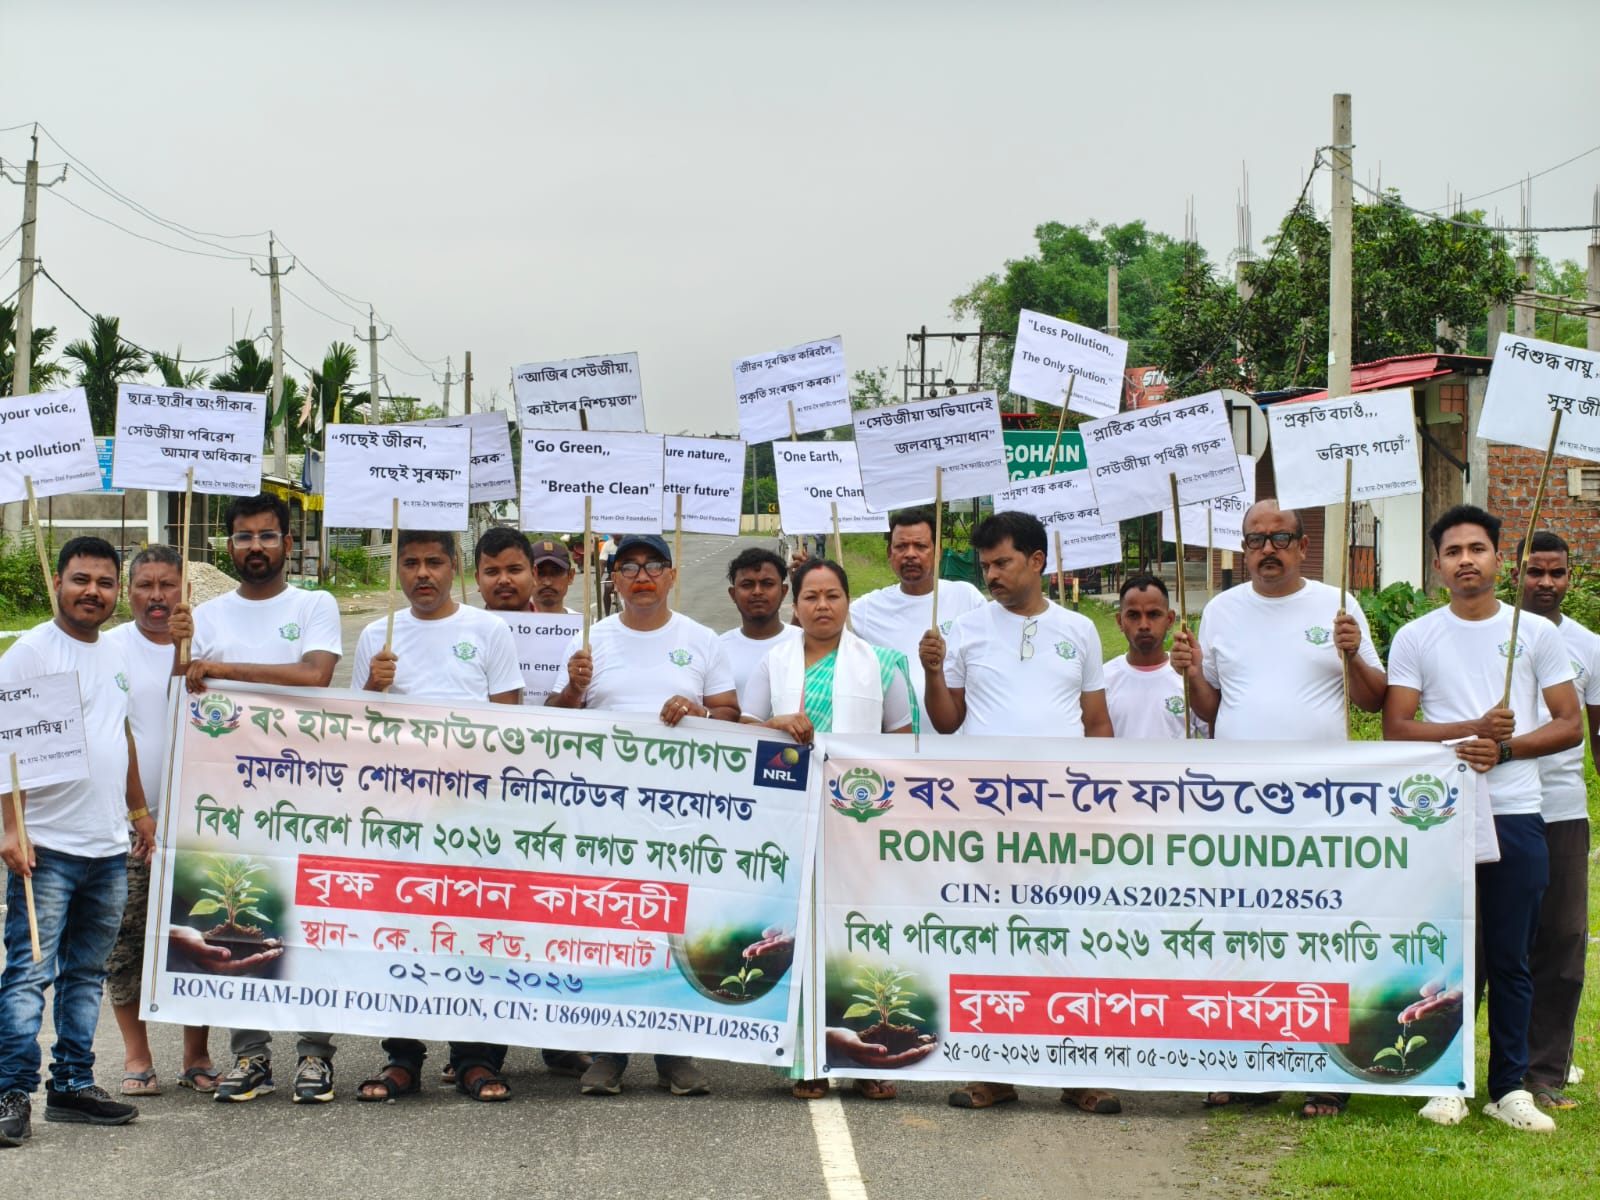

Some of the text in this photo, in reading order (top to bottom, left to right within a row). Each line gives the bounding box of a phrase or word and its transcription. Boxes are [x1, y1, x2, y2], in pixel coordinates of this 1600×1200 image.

[1022, 350, 1040, 364] The
[1043, 357, 1065, 372] Only
[0, 408, 30, 424] your
[160, 447, 200, 459] আমাৰ
[809, 450, 842, 463] Earth,
[370, 464, 408, 481] গছেই
[836, 486, 864, 497] Chan
[518, 624, 531, 634] to
[248, 705, 752, 773] ৰং হাম-দৈ ফাউণ্ডেশ্যনৰ উদ্যোগত
[235, 748, 757, 822] নুমলীগড় শোধনাগাৰ লিমিটেডৰ সহযোগত
[762, 768, 796, 783] NRL
[904, 766, 1383, 817] ৰং হাম-দৈ ফাউণ্ডেশ্যন
[195, 793, 789, 883] বিশ্ব পৰিৱেশ দিৱস ২০২৬ বৰ্ষৰ লগত সংগতি ৰাখি
[879, 829, 1408, 869] RONG HAM-DOI FOUNDATION
[304, 868, 678, 929] বৃক্ষ ৰোপন কাৰ্যসূচী
[940, 883, 1343, 911] CIN: U86909AS2025NPL028563
[545, 936, 655, 969] গোলাঘাট
[844, 910, 1448, 966] বিশ্ব পৰিৱেশ দিৱস ২০২৬ বৰ্ষৰ লগত সংগতি ৰাখি
[389, 961, 583, 994] ০২-০৬-২০২৬
[172, 977, 780, 1044] RONG HAM-DOI FOUNDATION, CIN: U86909AS2025NPL028563
[955, 982, 1337, 1040] বৃক্ষ ৰোপন কাৰ্যসূচী
[943, 1037, 1329, 1073] ২৫-০৫-২০২৬ তাৰিখৰ পৰা ০৫-০৬-২০২৬ তাৰিখলৈকে
